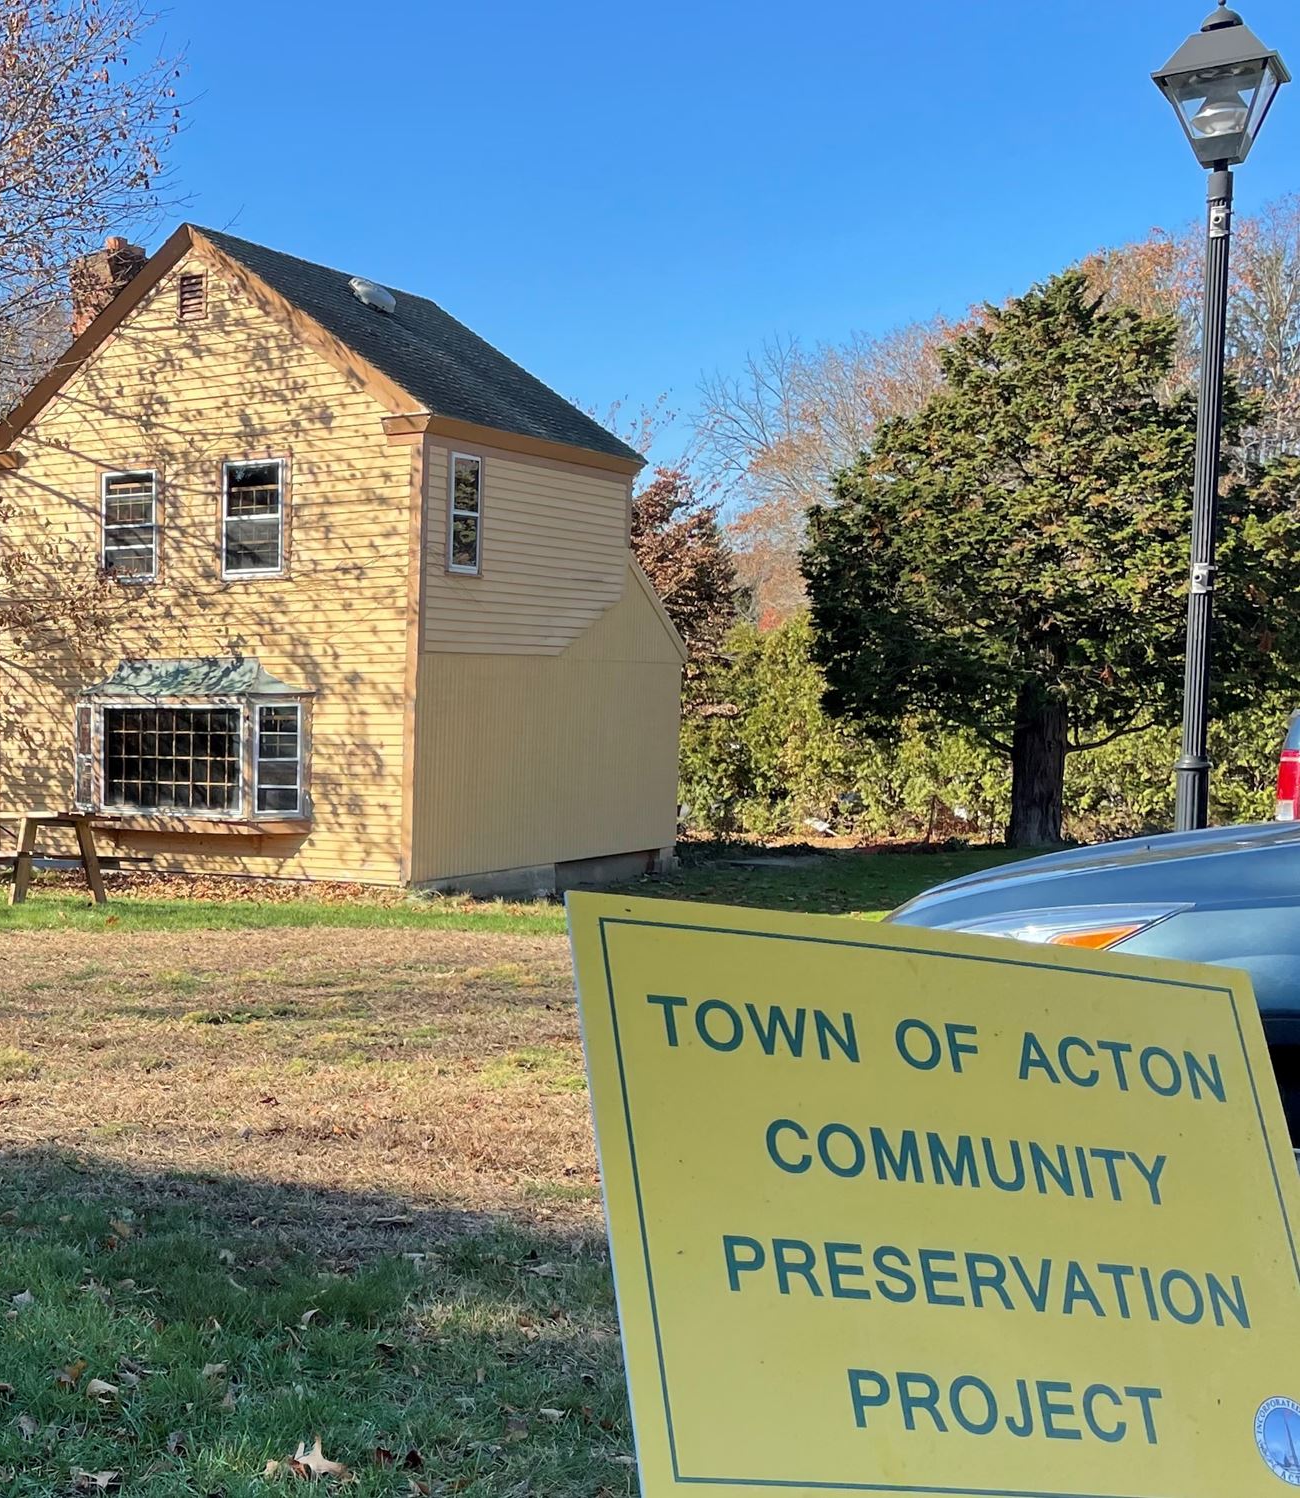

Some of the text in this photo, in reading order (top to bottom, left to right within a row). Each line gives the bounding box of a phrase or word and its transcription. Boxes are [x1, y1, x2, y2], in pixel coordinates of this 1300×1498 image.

[646, 994, 1226, 1102] TOWN OF ACTON
[765, 1118, 1166, 1205] COMMUNITY
[722, 1235, 1250, 1329] PRESERVATION
[847, 1369, 1162, 1444] PROJECT
